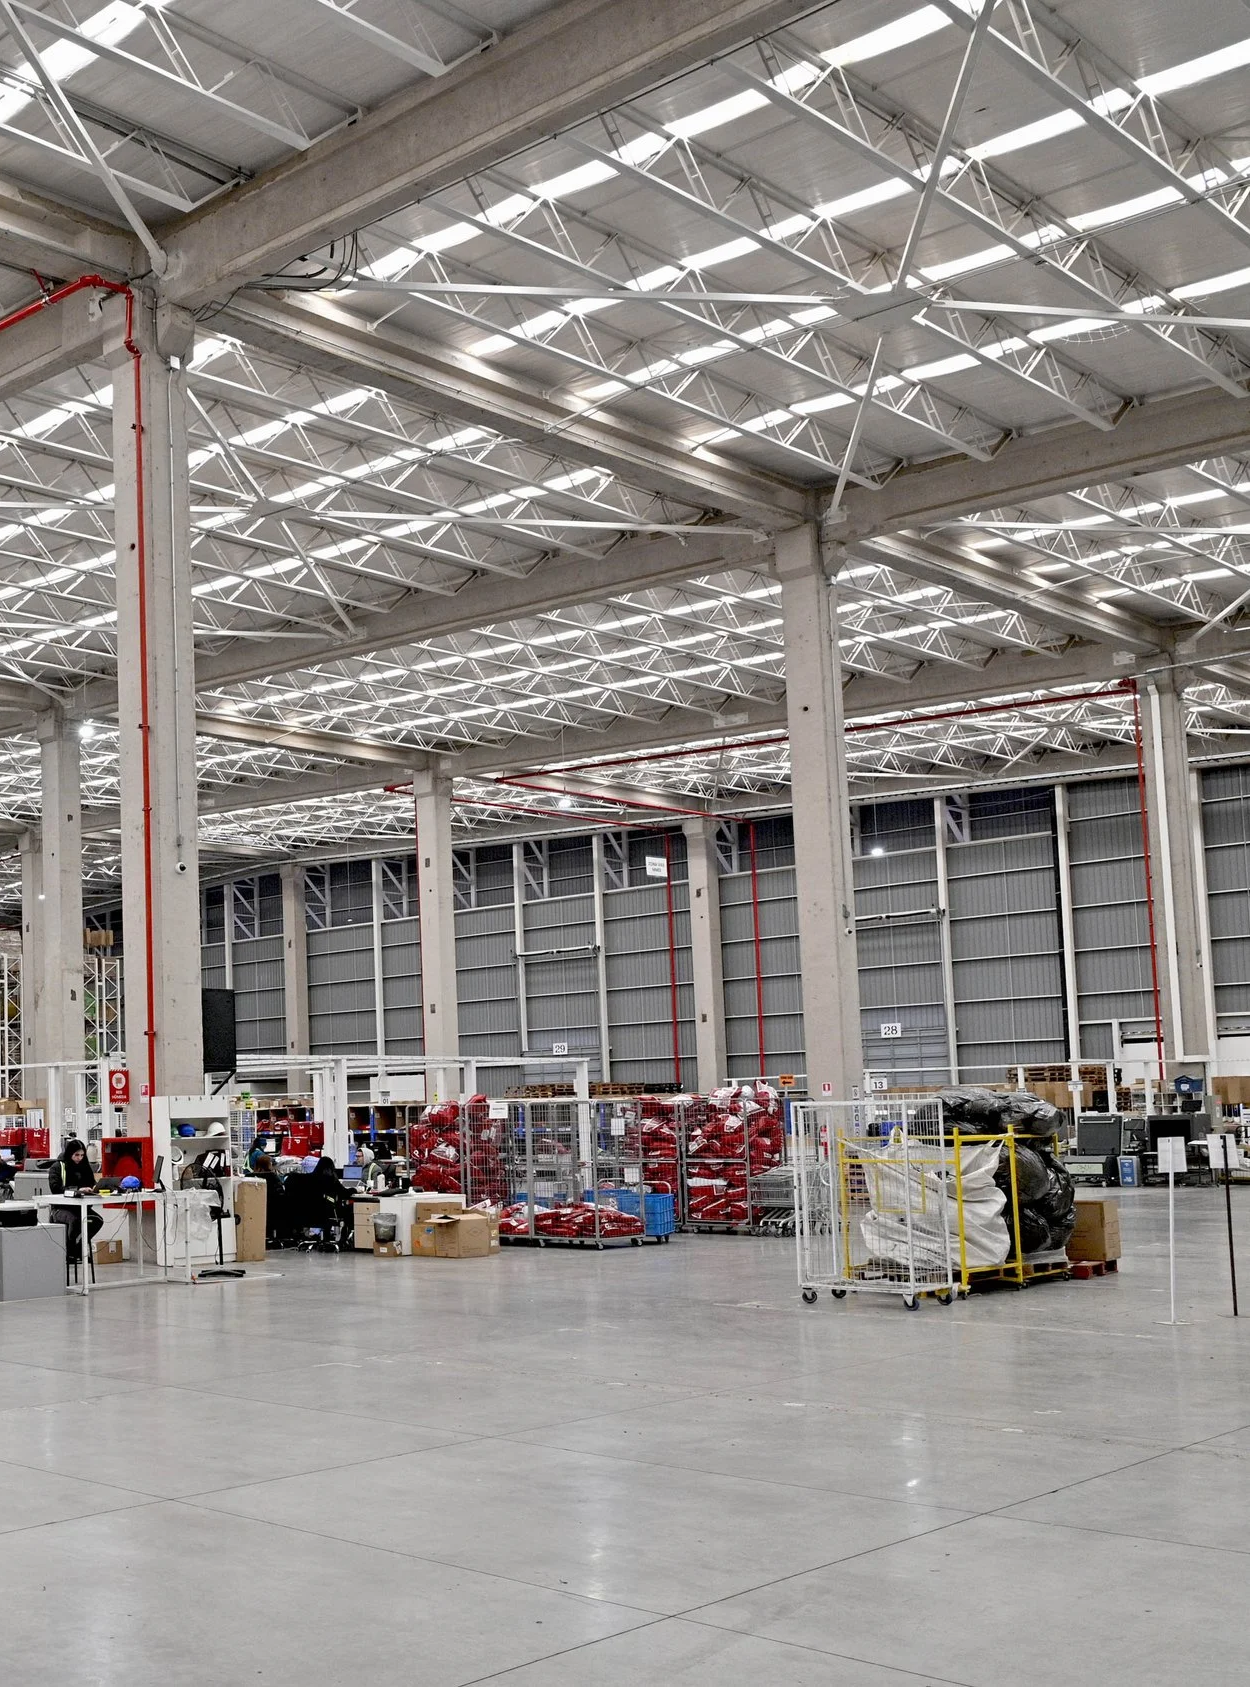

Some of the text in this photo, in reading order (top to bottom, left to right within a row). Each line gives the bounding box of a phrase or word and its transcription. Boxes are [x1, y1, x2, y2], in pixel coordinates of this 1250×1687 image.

[883, 1025, 898, 1036] 28
[555, 1044, 566, 1053] 29
[873, 1081, 883, 1089] 13
